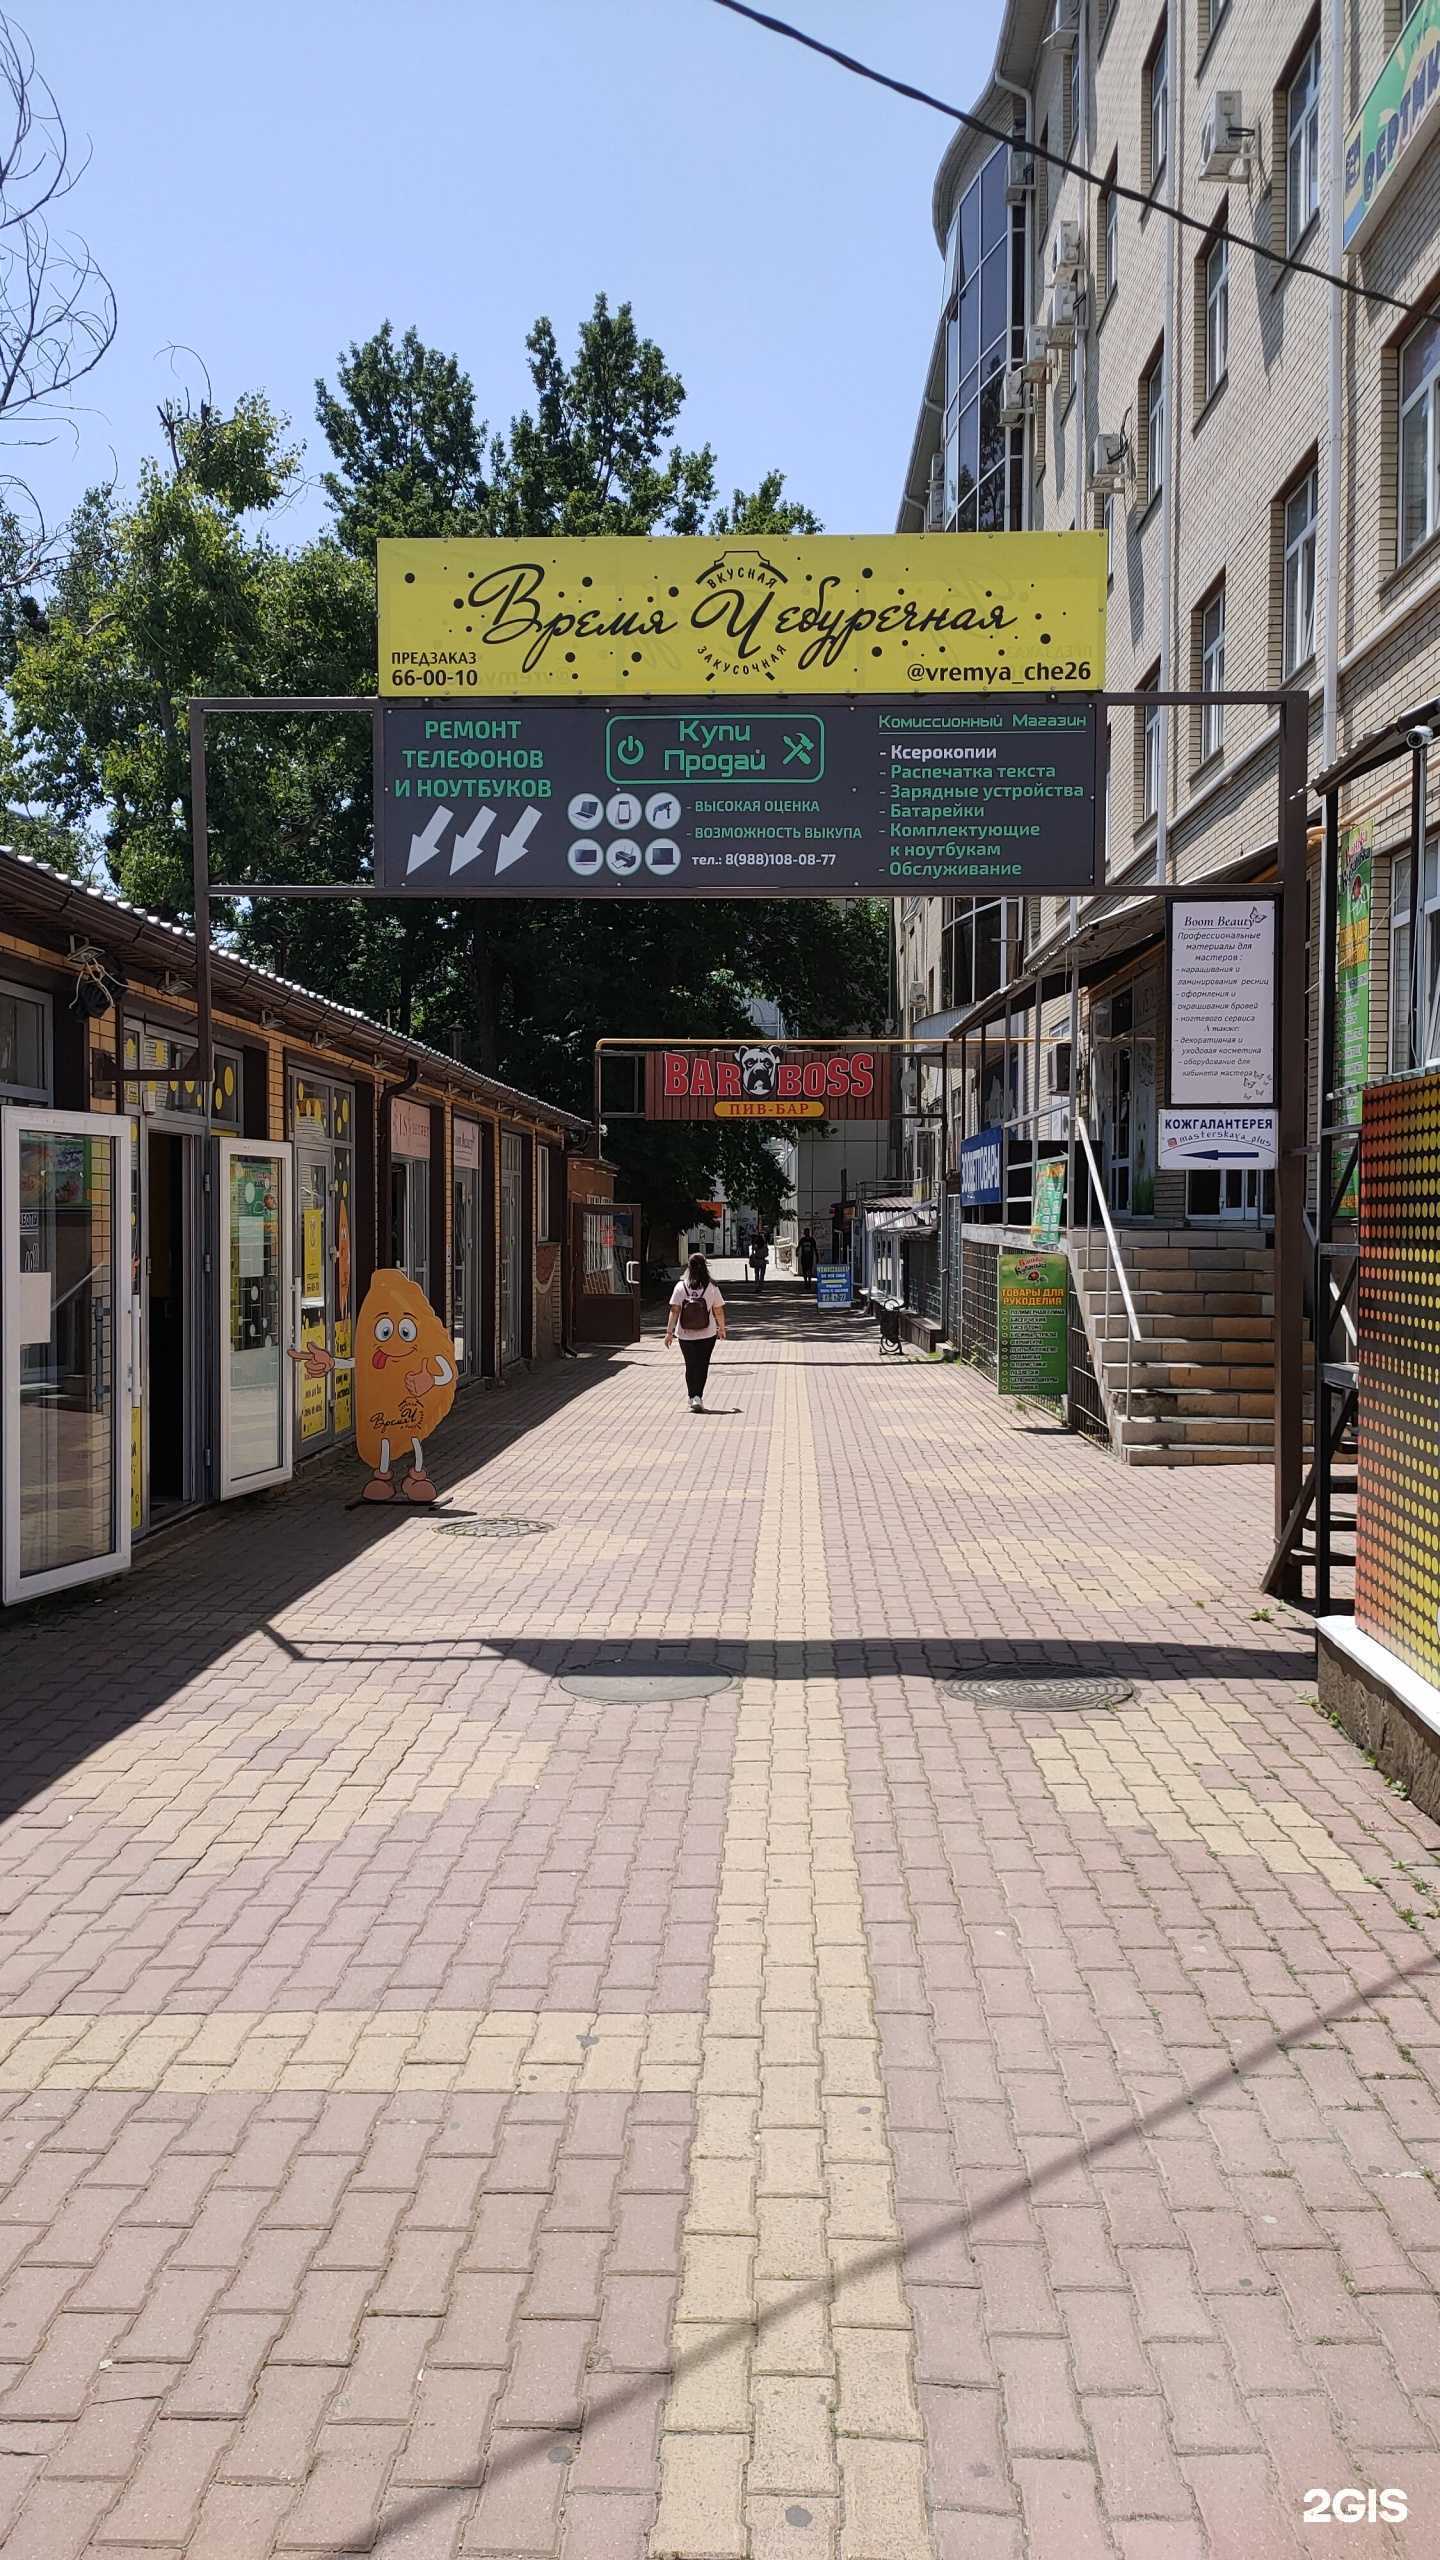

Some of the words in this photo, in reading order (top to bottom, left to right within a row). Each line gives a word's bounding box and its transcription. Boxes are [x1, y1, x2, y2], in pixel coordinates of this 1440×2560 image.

[707, 567, 778, 589] ВКУСНАЯ
[468, 563, 678, 674] Время
[691, 576, 1018, 670] Чебуречная
[391, 652, 477, 666] ПРЕДЗАКАЗ
[697, 644, 787, 675] ЗАКУСОЧНАЯ
[391, 669, 478, 687] 66-00-10
[907, 661, 1091, 684] @vremya_che26
[424, 720, 522, 740] РЕМОНТ
[878, 714, 1003, 729] Комиссионный
[1012, 713, 1087, 729] Магазин
[679, 720, 751, 748] Купи
[402, 749, 544, 769] ТЕЛЕФОНОВ
[890, 744, 997, 763] Ксерокопии
[664, 748, 766, 778] Продай
[890, 765, 993, 780] Распечатка
[997, 765, 1056, 778] текста
[395, 780, 410, 798] И
[417, 779, 552, 799] НОУТБУКОВ
[890, 784, 979, 801] Зарядные
[983, 782, 1084, 800] устройства
[695, 800, 761, 812] ВЫСОКАЯ
[764, 800, 820, 814] ОЦЕНКА
[890, 802, 984, 821] Батарейки
[695, 827, 801, 839] ВОЗМОЖНОСТЬ
[804, 827, 862, 839] ВЫКУПА
[890, 822, 1040, 840] Комплектующие
[890, 844, 903, 857] к
[906, 842, 1001, 860] ноутбукам
[692, 855, 722, 866] тел.:
[725, 853, 836, 868] 8(988)108-08-77
[889, 861, 1022, 879] Обслуживание
[1184, 916, 1214, 927] Boom
[1217, 916, 1254, 930] Beauty
[1177, 931, 1262, 941] Профессиональные
[1237, 942, 1252, 950] для
[664, 1052, 742, 1097] BAR
[776, 1052, 874, 1098] BOSS
[729, 1101, 810, 1116] ПИВ-БАР
[1165, 1118, 1273, 1130] КОЖГАЛАНТЕРЕЯ
[1001, 1288, 1041, 1297] ТОВАРЫ
